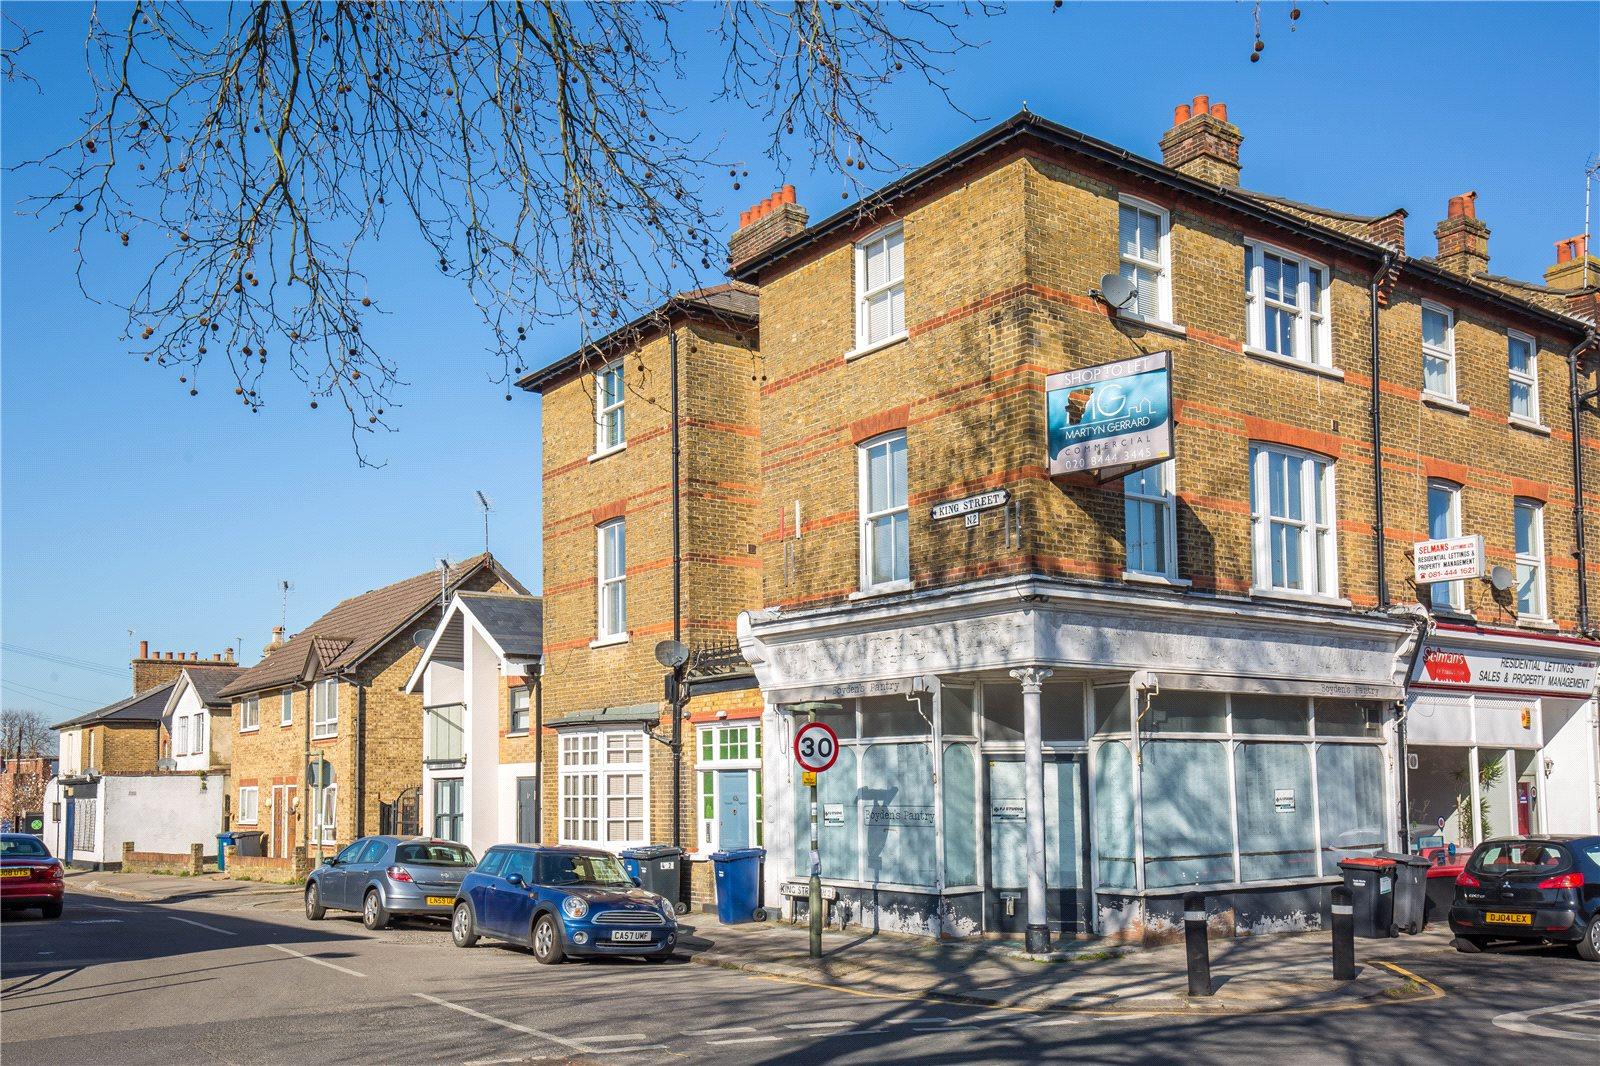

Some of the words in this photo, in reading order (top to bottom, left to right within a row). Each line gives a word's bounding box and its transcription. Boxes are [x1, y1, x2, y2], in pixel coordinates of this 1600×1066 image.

[1064, 369, 1100, 386] SHOP
[1104, 363, 1123, 377] TO
[1127, 357, 1150, 374] LET
[1065, 425, 1106, 440] MARTYN
[1107, 416, 1151, 433] GERRARD
[1064, 434, 1151, 456] COMMERCIAL
[1065, 458, 1085, 470] 020
[1091, 453, 1118, 467] 8444
[1124, 447, 1152, 461] 3445
[939, 503, 959, 516] KING
[963, 494, 1000, 510] STREET
[966, 514, 977, 526] N2
[1417, 553, 1447, 563] RESIDENTIAL
[1448, 550, 1470, 560] LETTINGS
[1418, 543, 1449, 555] SELMANS
[1417, 562, 1441, 571] PROPERTY
[1443, 558, 1475, 568] MANAGEMENT
[1423, 646, 1464, 665] Selmans
[1500, 657, 1541, 671] RESIDENTIAL
[1544, 661, 1575, 674] LETTINGS
[870, 681, 901, 692] Pantry
[1479, 670, 1501, 683] SALES
[1503, 672, 1509, 683] &
[1512, 673, 1546, 686] PROPERTY
[1548, 675, 1590, 689] MANAGEMENT
[1354, 686, 1380, 697] Pantry
[800, 737, 832, 758] 30
[903, 810, 935, 824] Pantry
[780, 884, 796, 894] KING
[797, 885, 809, 895] STR
